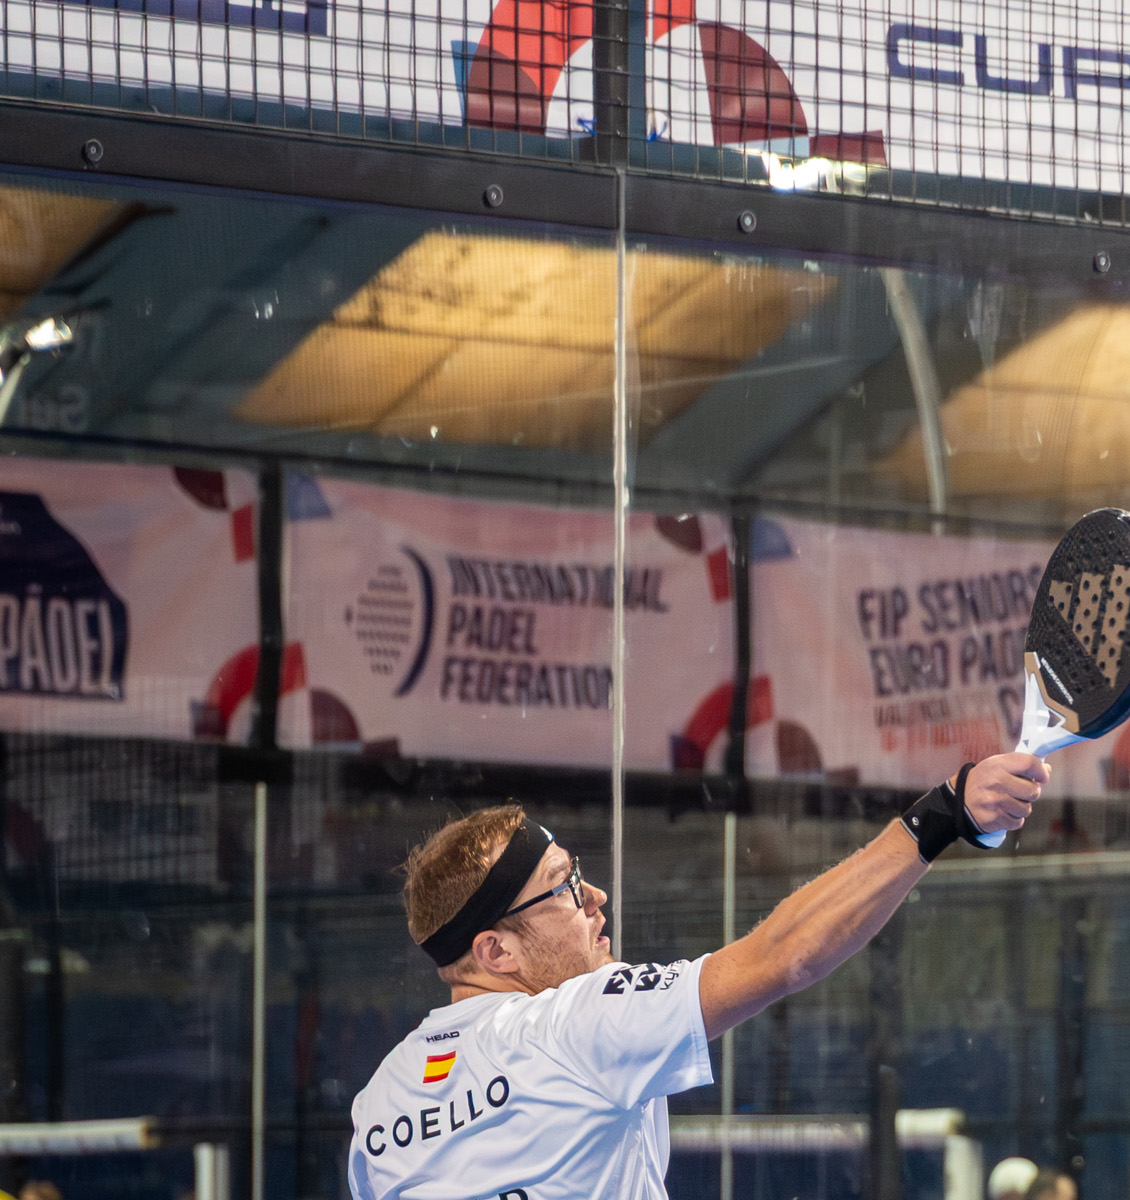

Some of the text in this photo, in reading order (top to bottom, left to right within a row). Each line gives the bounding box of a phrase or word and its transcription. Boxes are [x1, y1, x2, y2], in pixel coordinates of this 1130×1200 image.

[447, 603, 537, 655] PADEL
[857, 585, 909, 638] FIP
[426, 1030, 460, 1043] HEAD
[365, 1075, 510, 1157] COELLO
